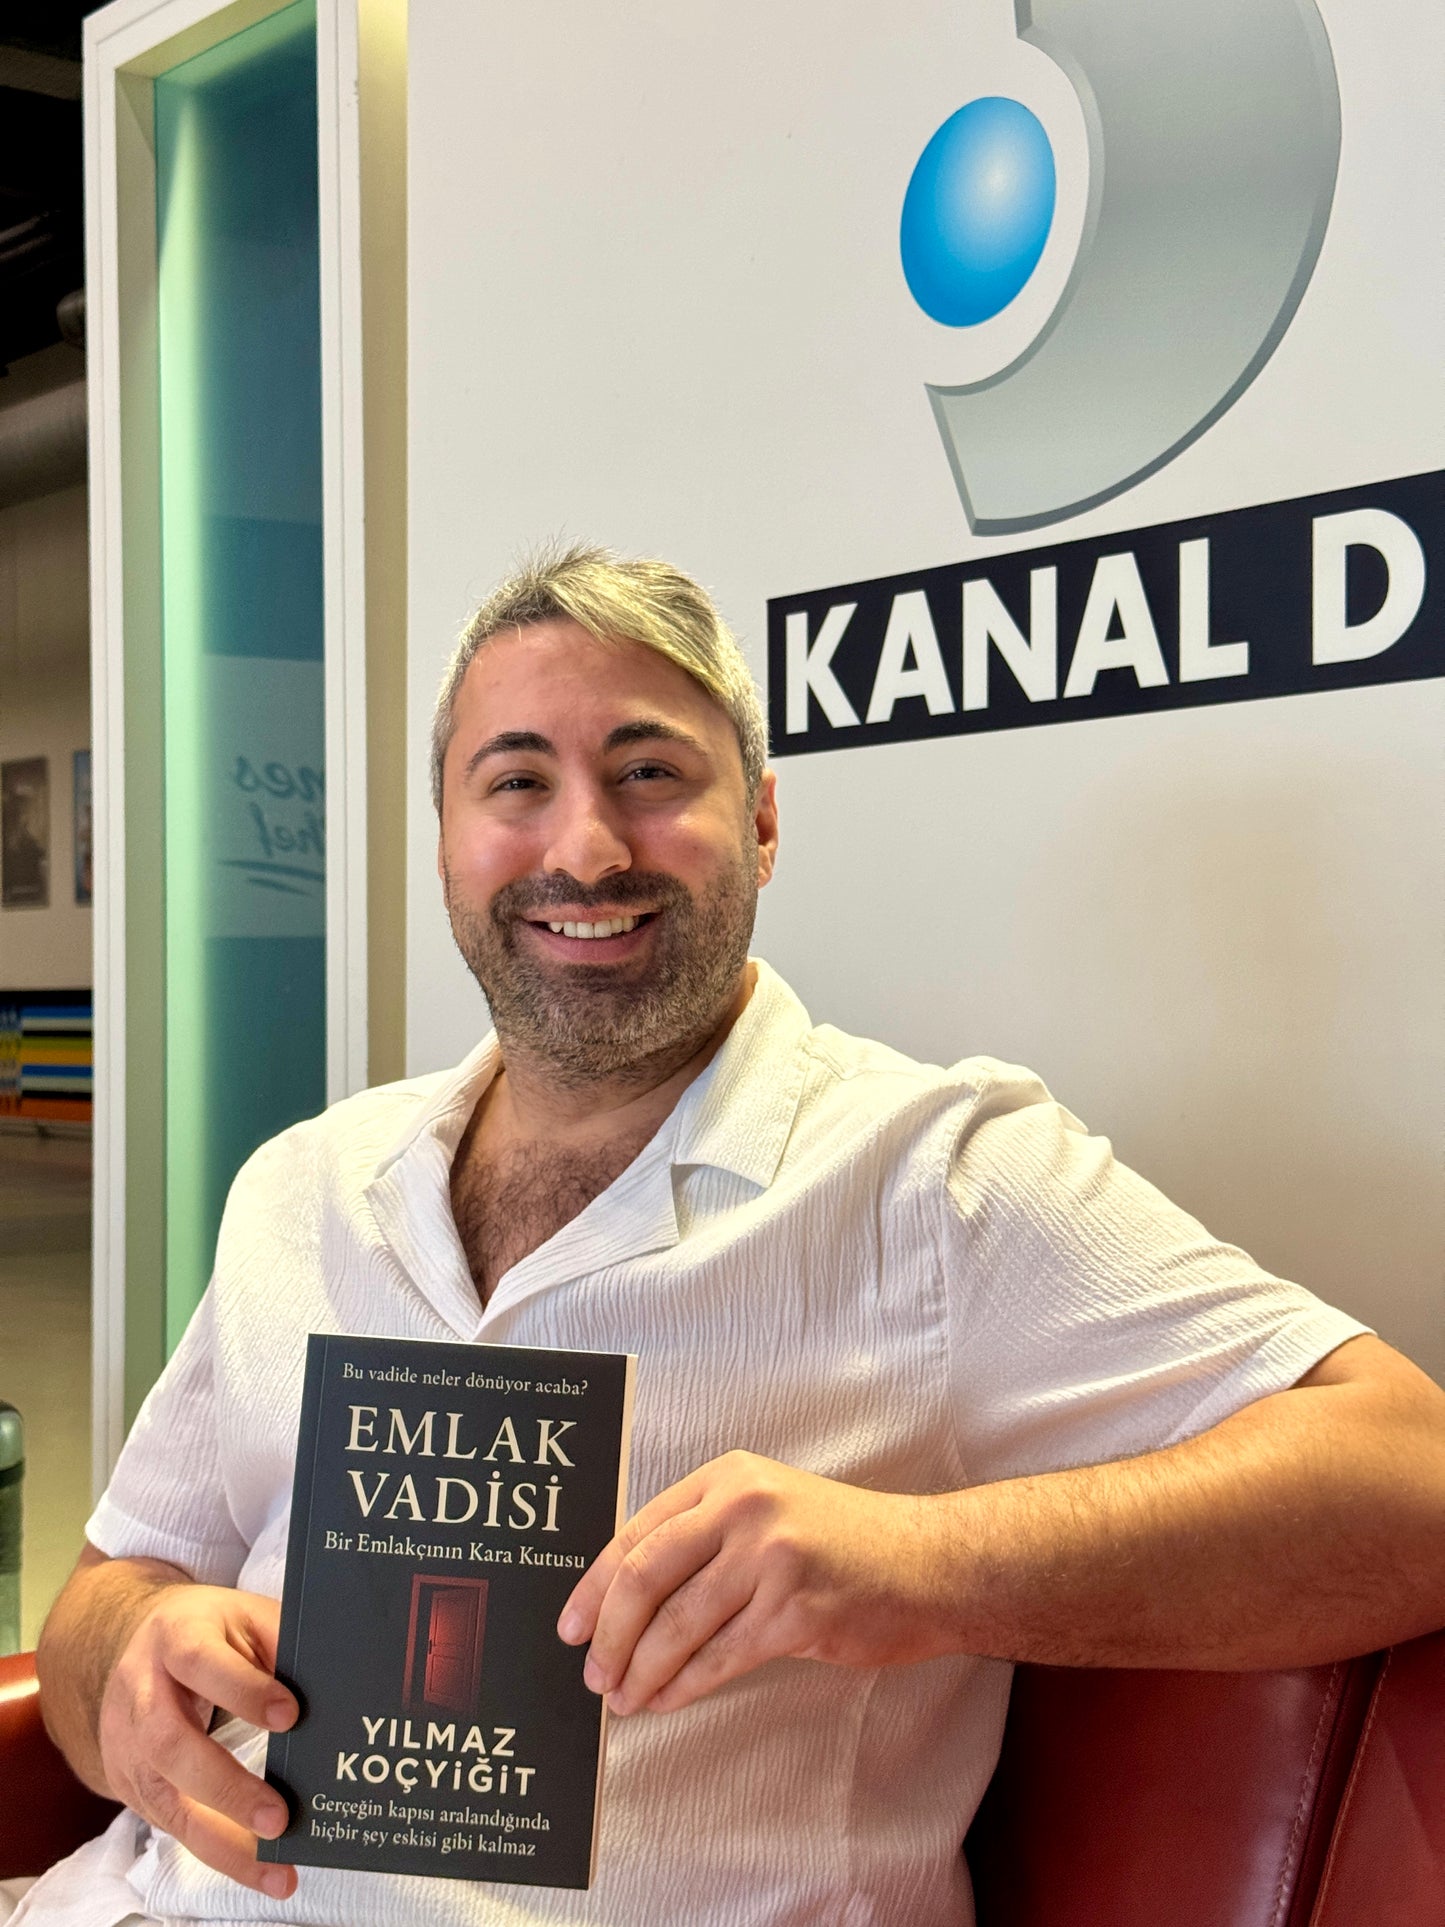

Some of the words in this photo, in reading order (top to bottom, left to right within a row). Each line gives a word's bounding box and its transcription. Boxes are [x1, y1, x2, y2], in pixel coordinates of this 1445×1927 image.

[785, 537, 1249, 735] KANAL
[1312, 508, 1426, 666] D
[343, 1362, 364, 1380] Bu
[369, 1366, 418, 1384] vadide
[423, 1370, 461, 1387] neler
[465, 1372, 532, 1395] dönüyor
[535, 1378, 589, 1396] acaba?
[344, 1405, 578, 1467] EMLAK
[346, 1470, 563, 1532] VADİSİ
[324, 1530, 353, 1551] Bir
[356, 1533, 463, 1561] Emlakçının
[468, 1542, 513, 1564] Kara
[518, 1546, 586, 1569] Kutusu
[361, 1716, 517, 1757] YILMAZ
[335, 1752, 536, 1796] KOÇYİĞİT
[311, 1793, 383, 1820] Gerçeğin
[388, 1800, 435, 1825] kapısı
[439, 1806, 551, 1832] aralandığında
[310, 1819, 359, 1842] hiçbir
[362, 1829, 389, 1848] şey
[392, 1828, 437, 1848] eskisi
[440, 1832, 473, 1854] gibi
[478, 1835, 537, 1857] kalmaz
